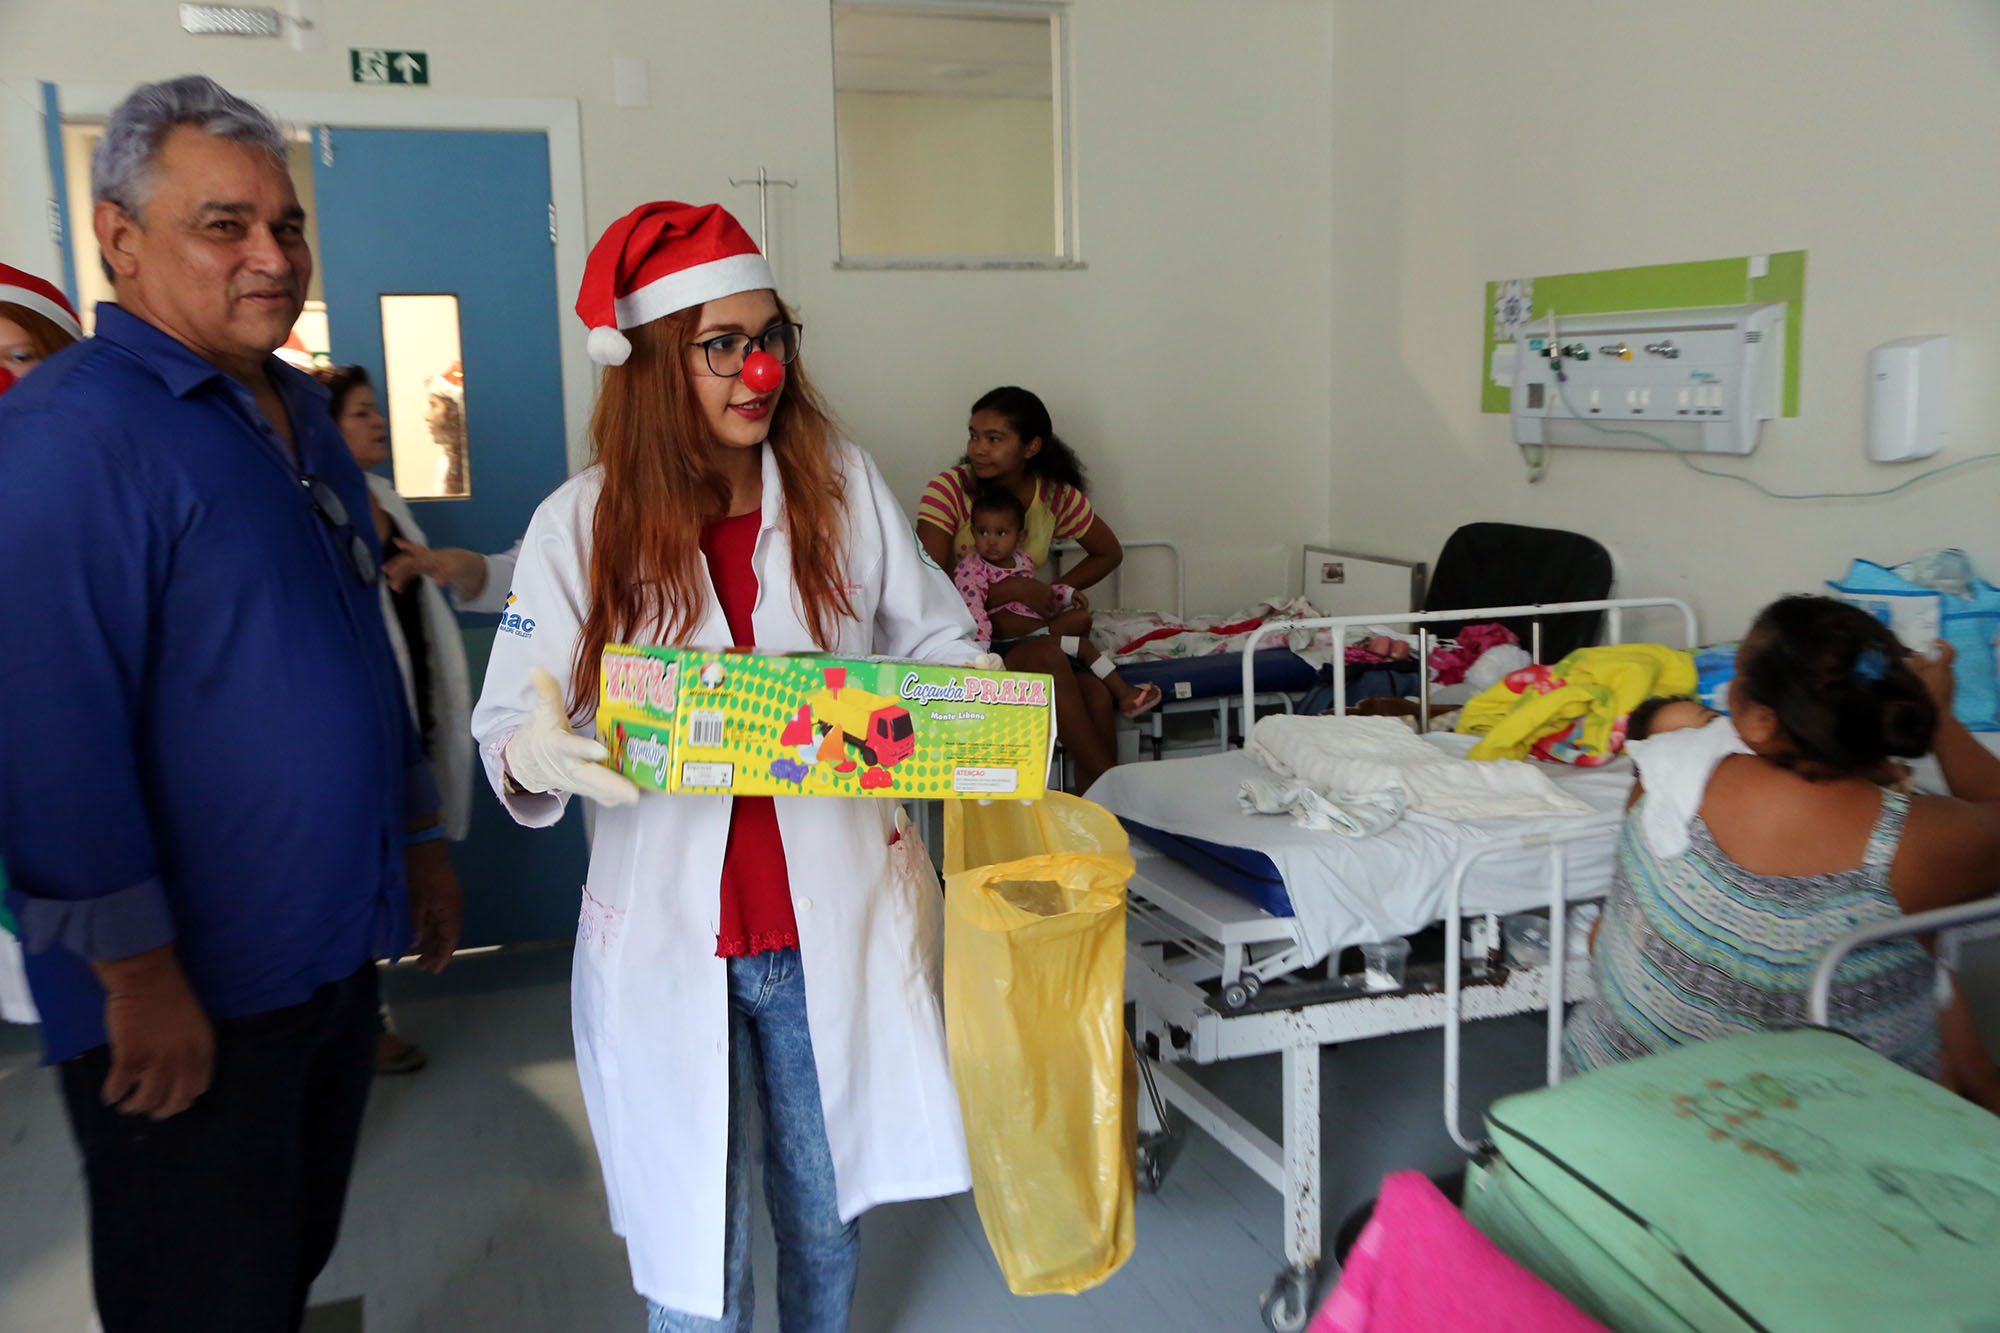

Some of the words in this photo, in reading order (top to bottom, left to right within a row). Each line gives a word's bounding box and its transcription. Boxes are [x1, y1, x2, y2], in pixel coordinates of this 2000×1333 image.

[605, 654, 676, 711] PRAIA
[901, 672, 964, 705] Caçamba
[964, 677, 1048, 706] PRAIA
[931, 711, 956, 720] Monte
